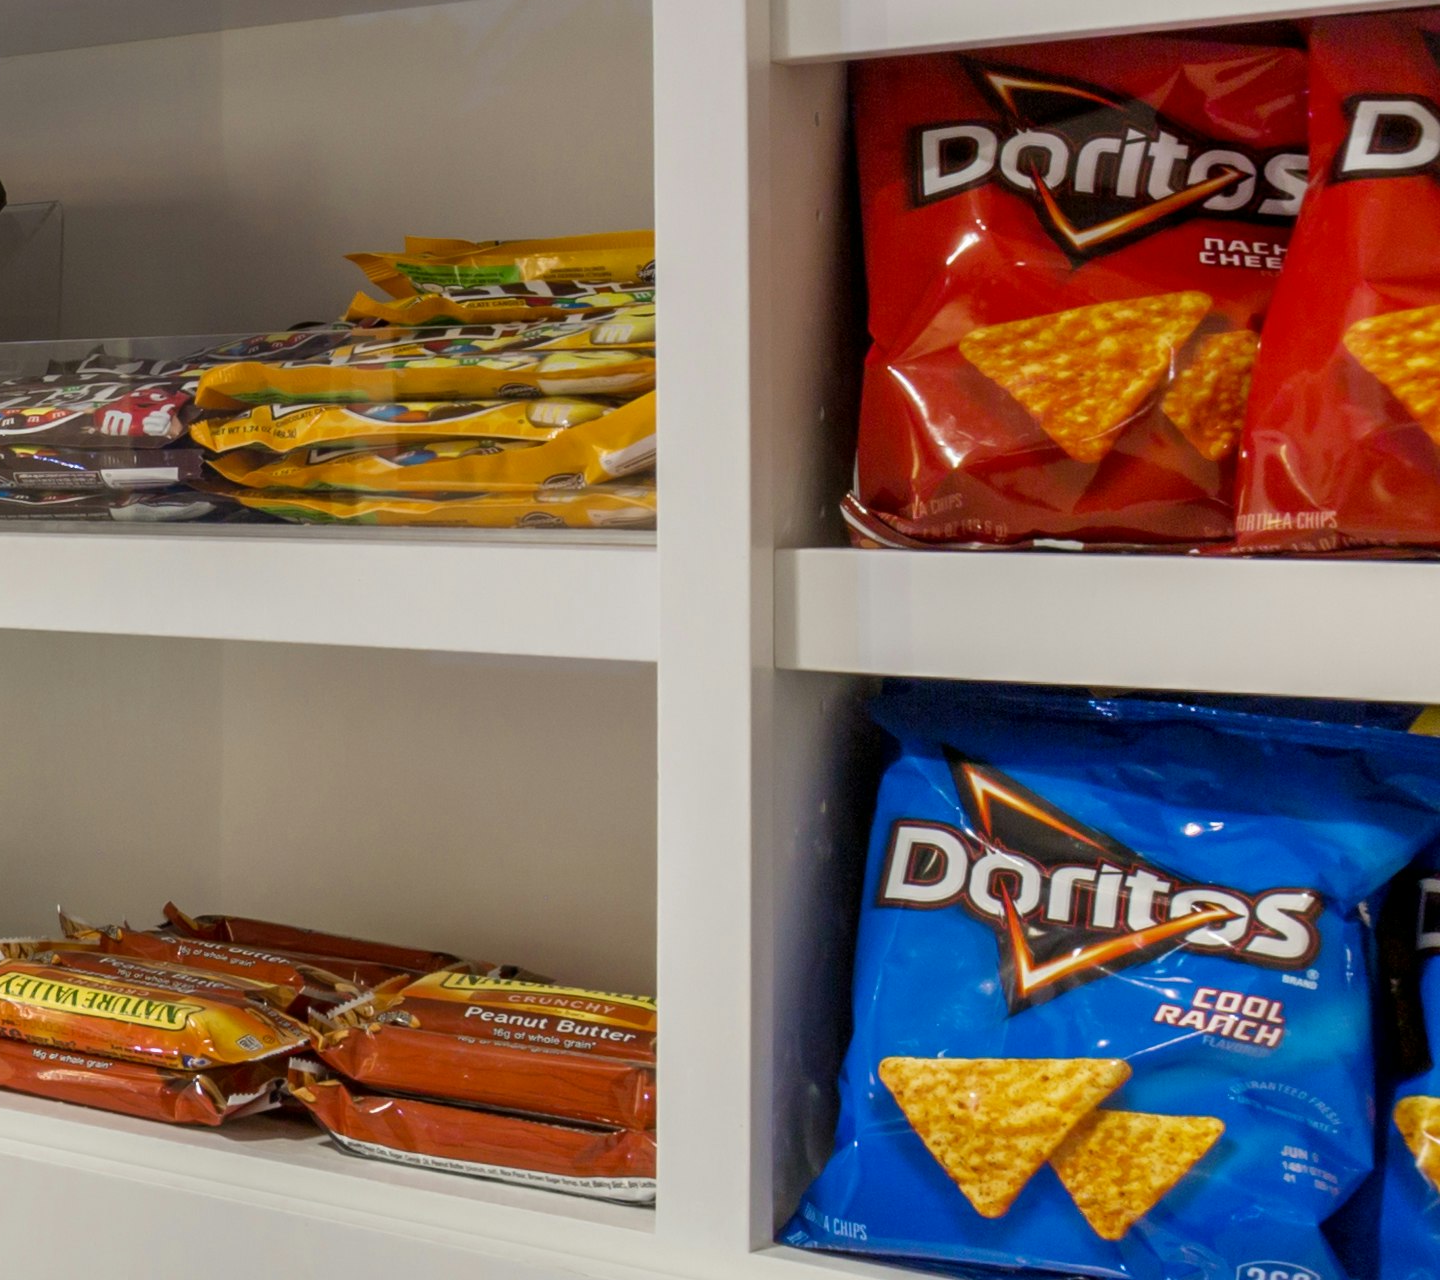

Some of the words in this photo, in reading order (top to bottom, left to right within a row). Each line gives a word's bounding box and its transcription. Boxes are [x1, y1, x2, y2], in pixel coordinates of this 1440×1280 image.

[921, 124, 1310, 215] Doritos
[1296, 510, 1339, 531] CHIPS
[883, 824, 1319, 962] Doritos
[85, 988, 180, 1025] NATURE
[508, 995, 616, 1015] CRUNCHY
[1192, 987, 1285, 1024] COOL
[464, 1006, 548, 1030] Peanut
[557, 1019, 636, 1044] Butter
[493, 1027, 511, 1040] 16g
[528, 1032, 560, 1046] whole
[1153, 1003, 1284, 1048] RANCH
[1281, 1145, 1308, 1161] JUN
[831, 1217, 868, 1242] CHIPS
